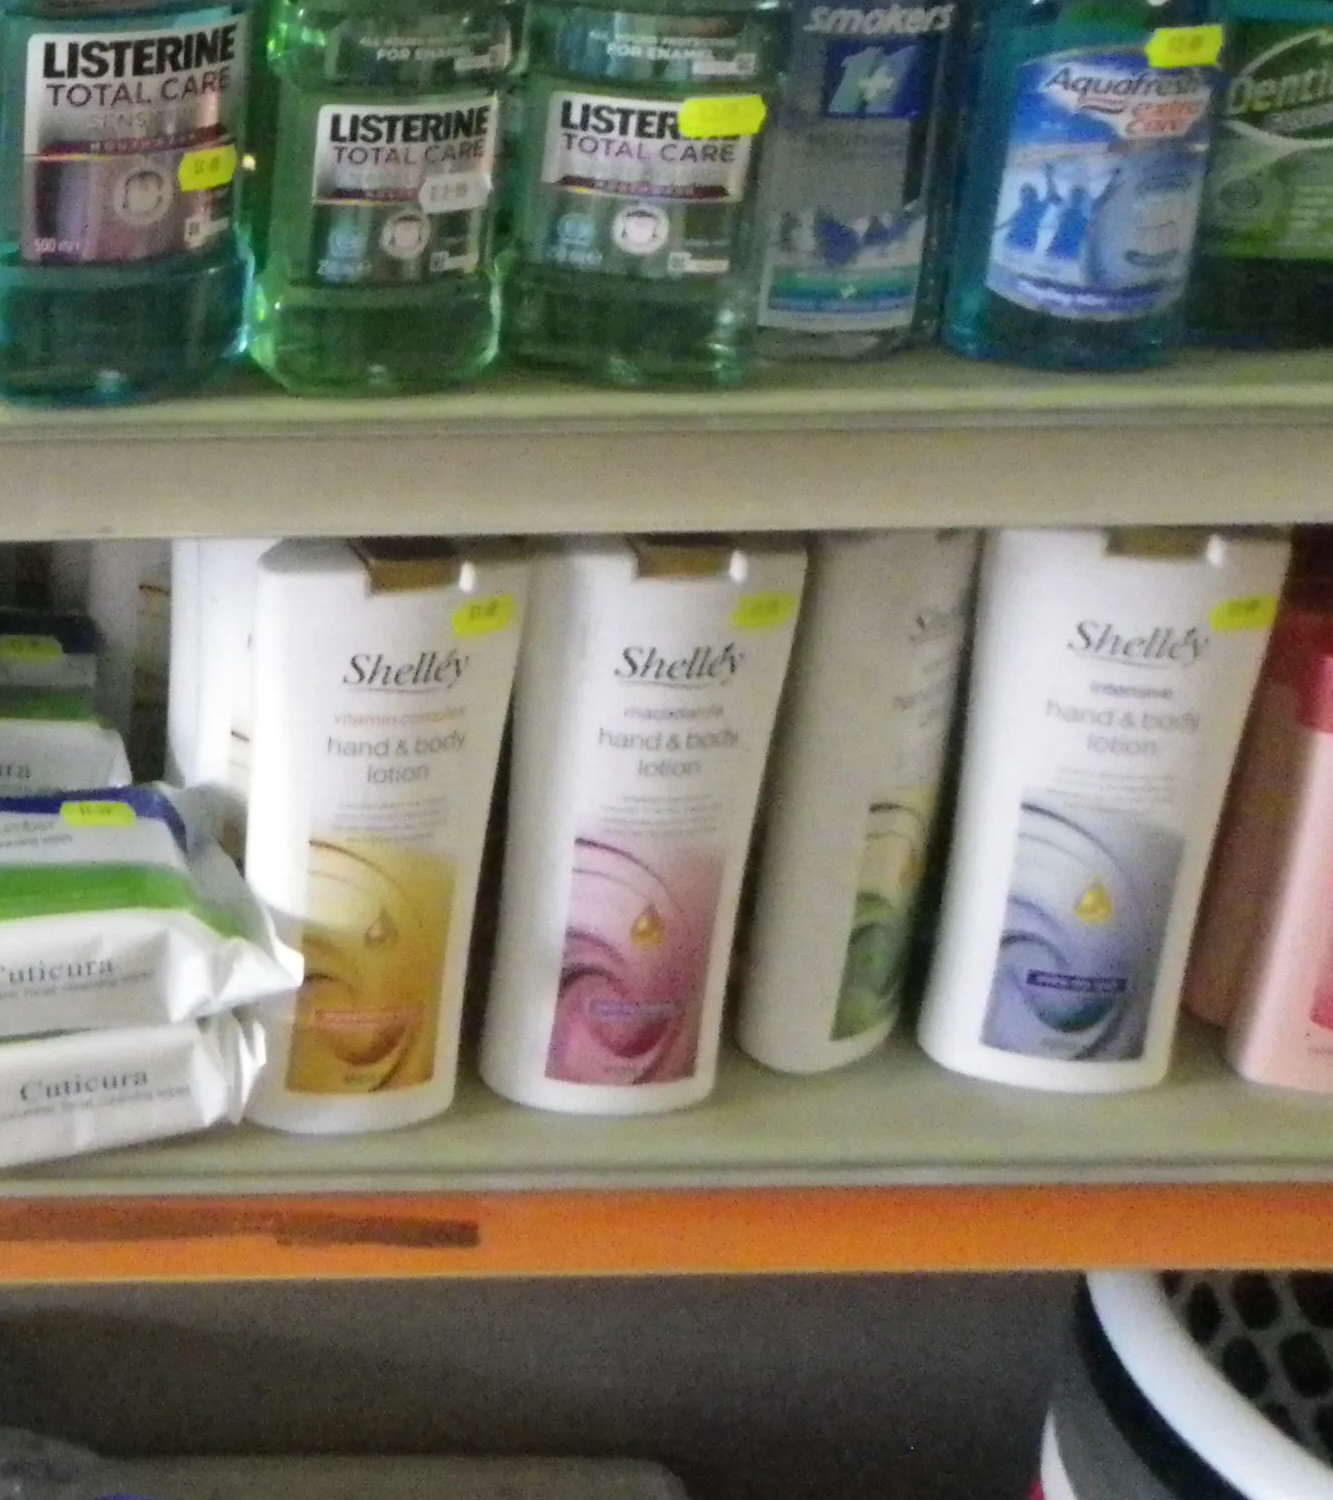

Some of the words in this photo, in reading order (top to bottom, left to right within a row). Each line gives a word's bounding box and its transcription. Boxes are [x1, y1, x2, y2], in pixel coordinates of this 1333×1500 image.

[803, 4, 956, 34] smokers
[43, 25, 237, 79] LISTERINE
[45, 82, 153, 108] TOTAL
[160, 71, 231, 103] CARE
[329, 105, 491, 143] LISTERINE
[560, 100, 740, 141] LISTER
[333, 146, 419, 166] TOTAL
[424, 139, 484, 165] CARE
[562, 132, 651, 162] TOTAL
[660, 142, 736, 164] CARE
[326, 735, 389, 758] hand
[395, 739, 409, 757] &
[414, 730, 466, 755] body
[598, 728, 662, 752] hand
[367, 763, 430, 784] lotion
[636, 757, 701, 778] lotion
[19, 1066, 150, 1103] Cuticura
